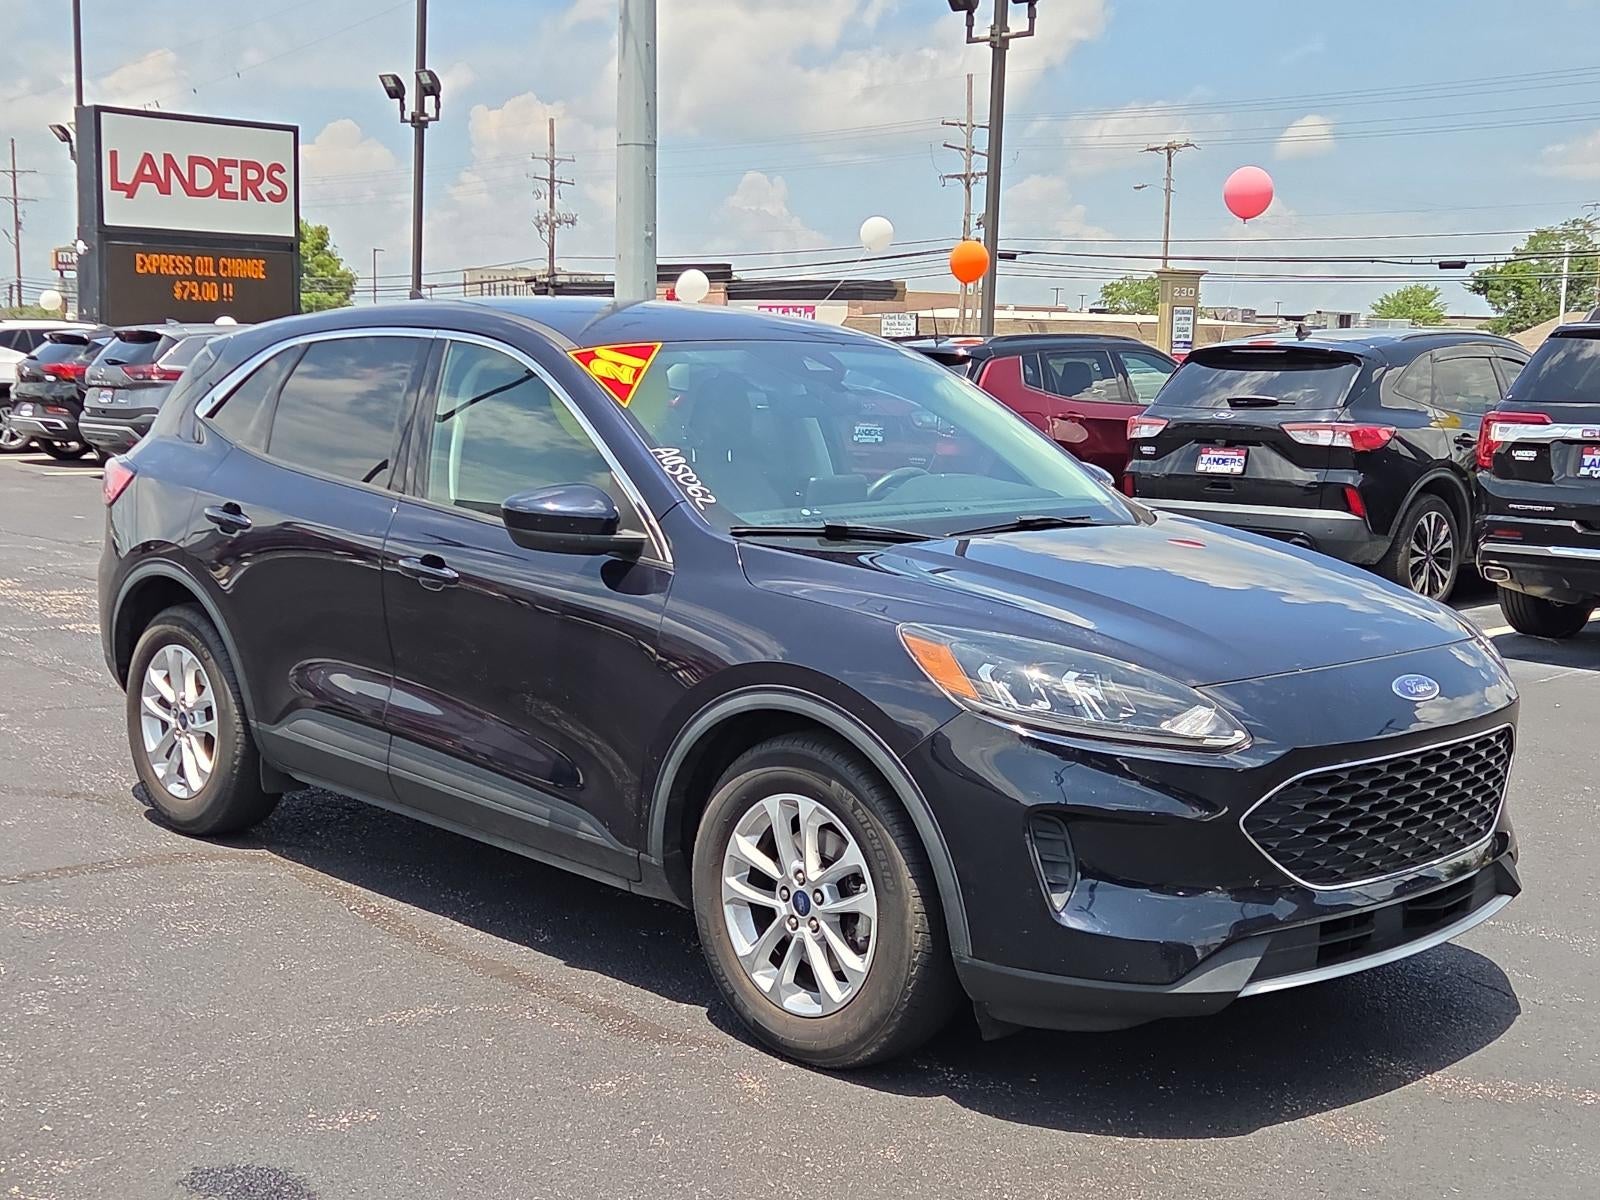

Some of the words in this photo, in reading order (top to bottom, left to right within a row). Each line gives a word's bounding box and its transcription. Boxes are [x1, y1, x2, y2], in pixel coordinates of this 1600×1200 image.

[109, 149, 288, 203] LANDERS
[135, 253, 193, 275] EXPRESS
[194, 256, 217, 277] OIL
[218, 257, 266, 279] CHANGE
[173, 280, 219, 302] $79.00
[222, 282, 234, 302] !!
[1173, 287, 1196, 297] 230
[589, 348, 646, 385] 21
[1200, 456, 1244, 467] LANDERS
[1404, 678, 1432, 694] Ford
